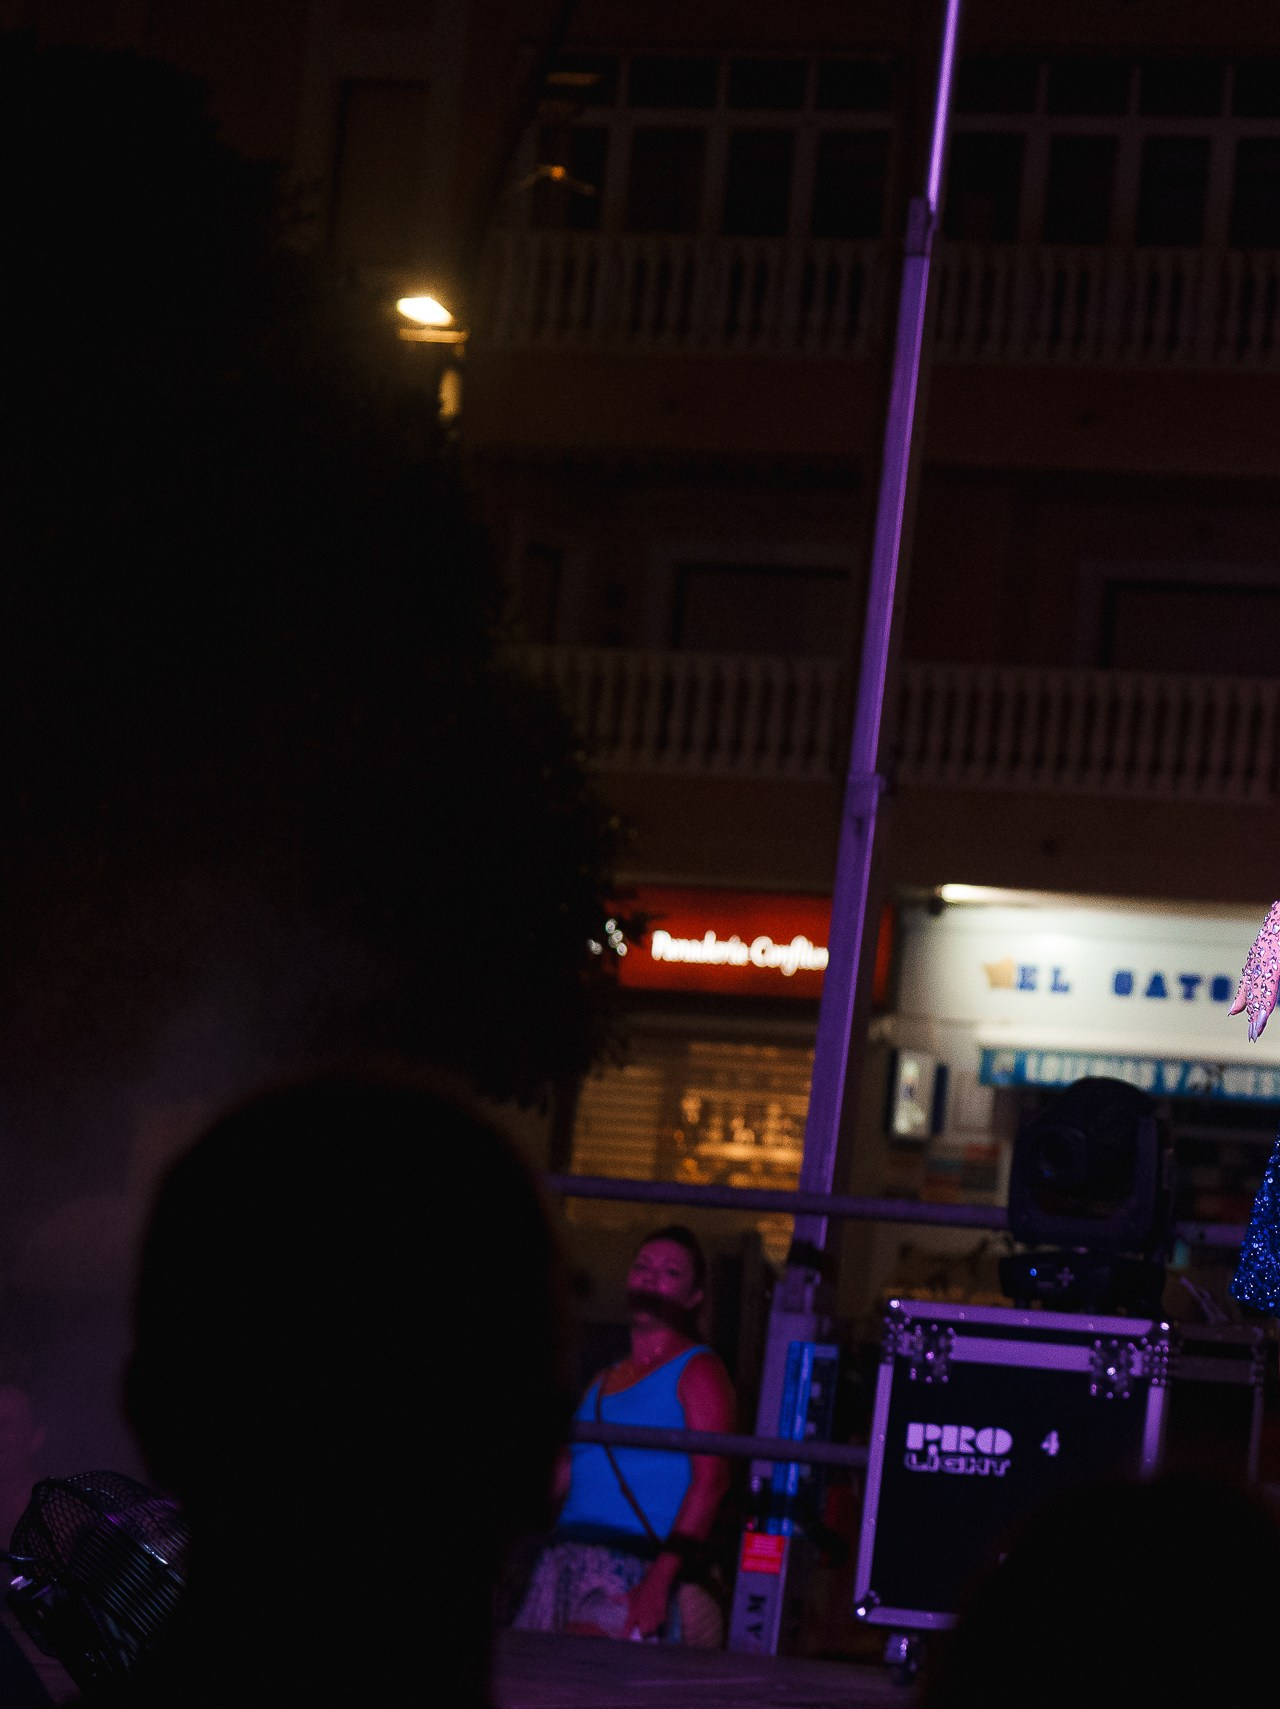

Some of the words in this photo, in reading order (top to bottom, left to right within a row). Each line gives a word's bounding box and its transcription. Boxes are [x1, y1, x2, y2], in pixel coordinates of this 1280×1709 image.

[1016, 963, 1070, 994] EL
[905, 1421, 1014, 1456] PRO
[1040, 1429, 1061, 1457] 4
